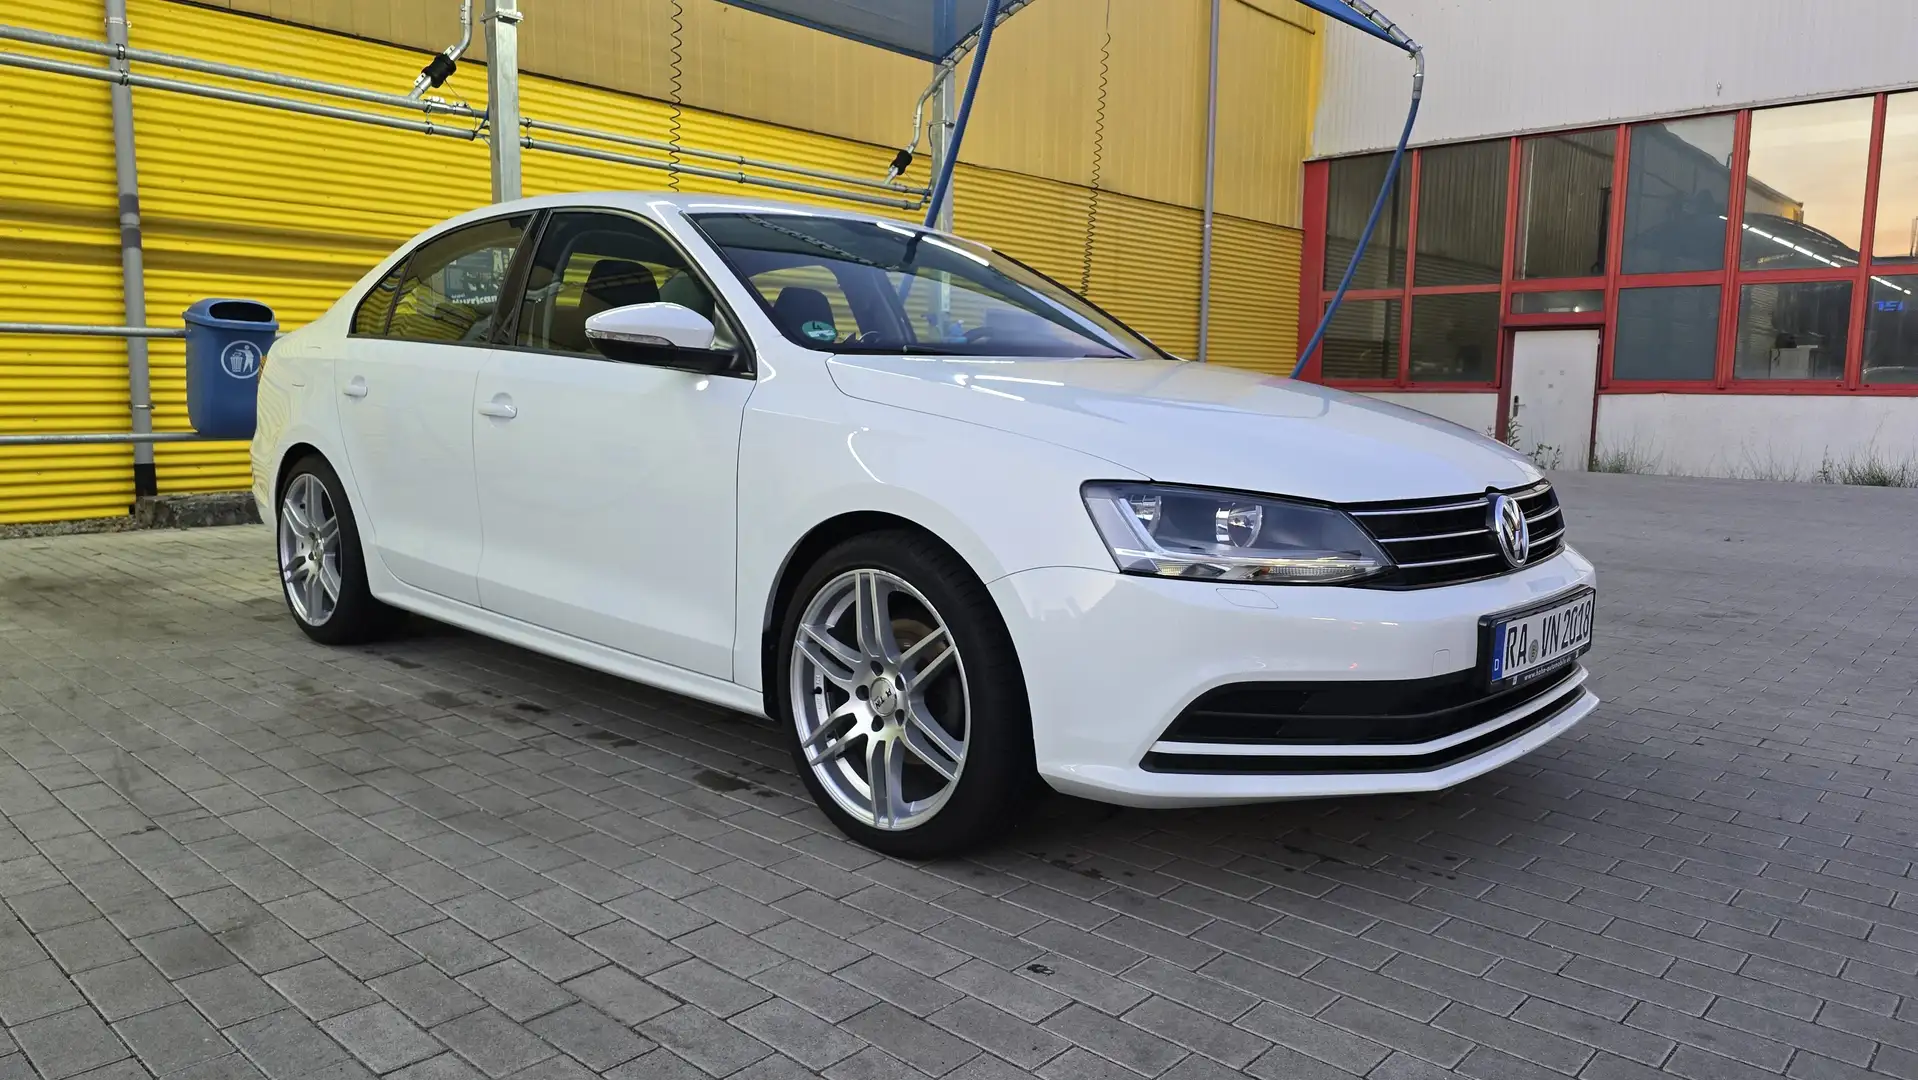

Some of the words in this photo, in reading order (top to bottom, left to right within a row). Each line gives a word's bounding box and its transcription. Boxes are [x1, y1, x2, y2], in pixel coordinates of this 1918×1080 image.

[1505, 623, 1528, 671] RA
[1541, 612, 1561, 658] VN
[1561, 600, 1591, 649] 2018
[1494, 658, 1500, 671] D
